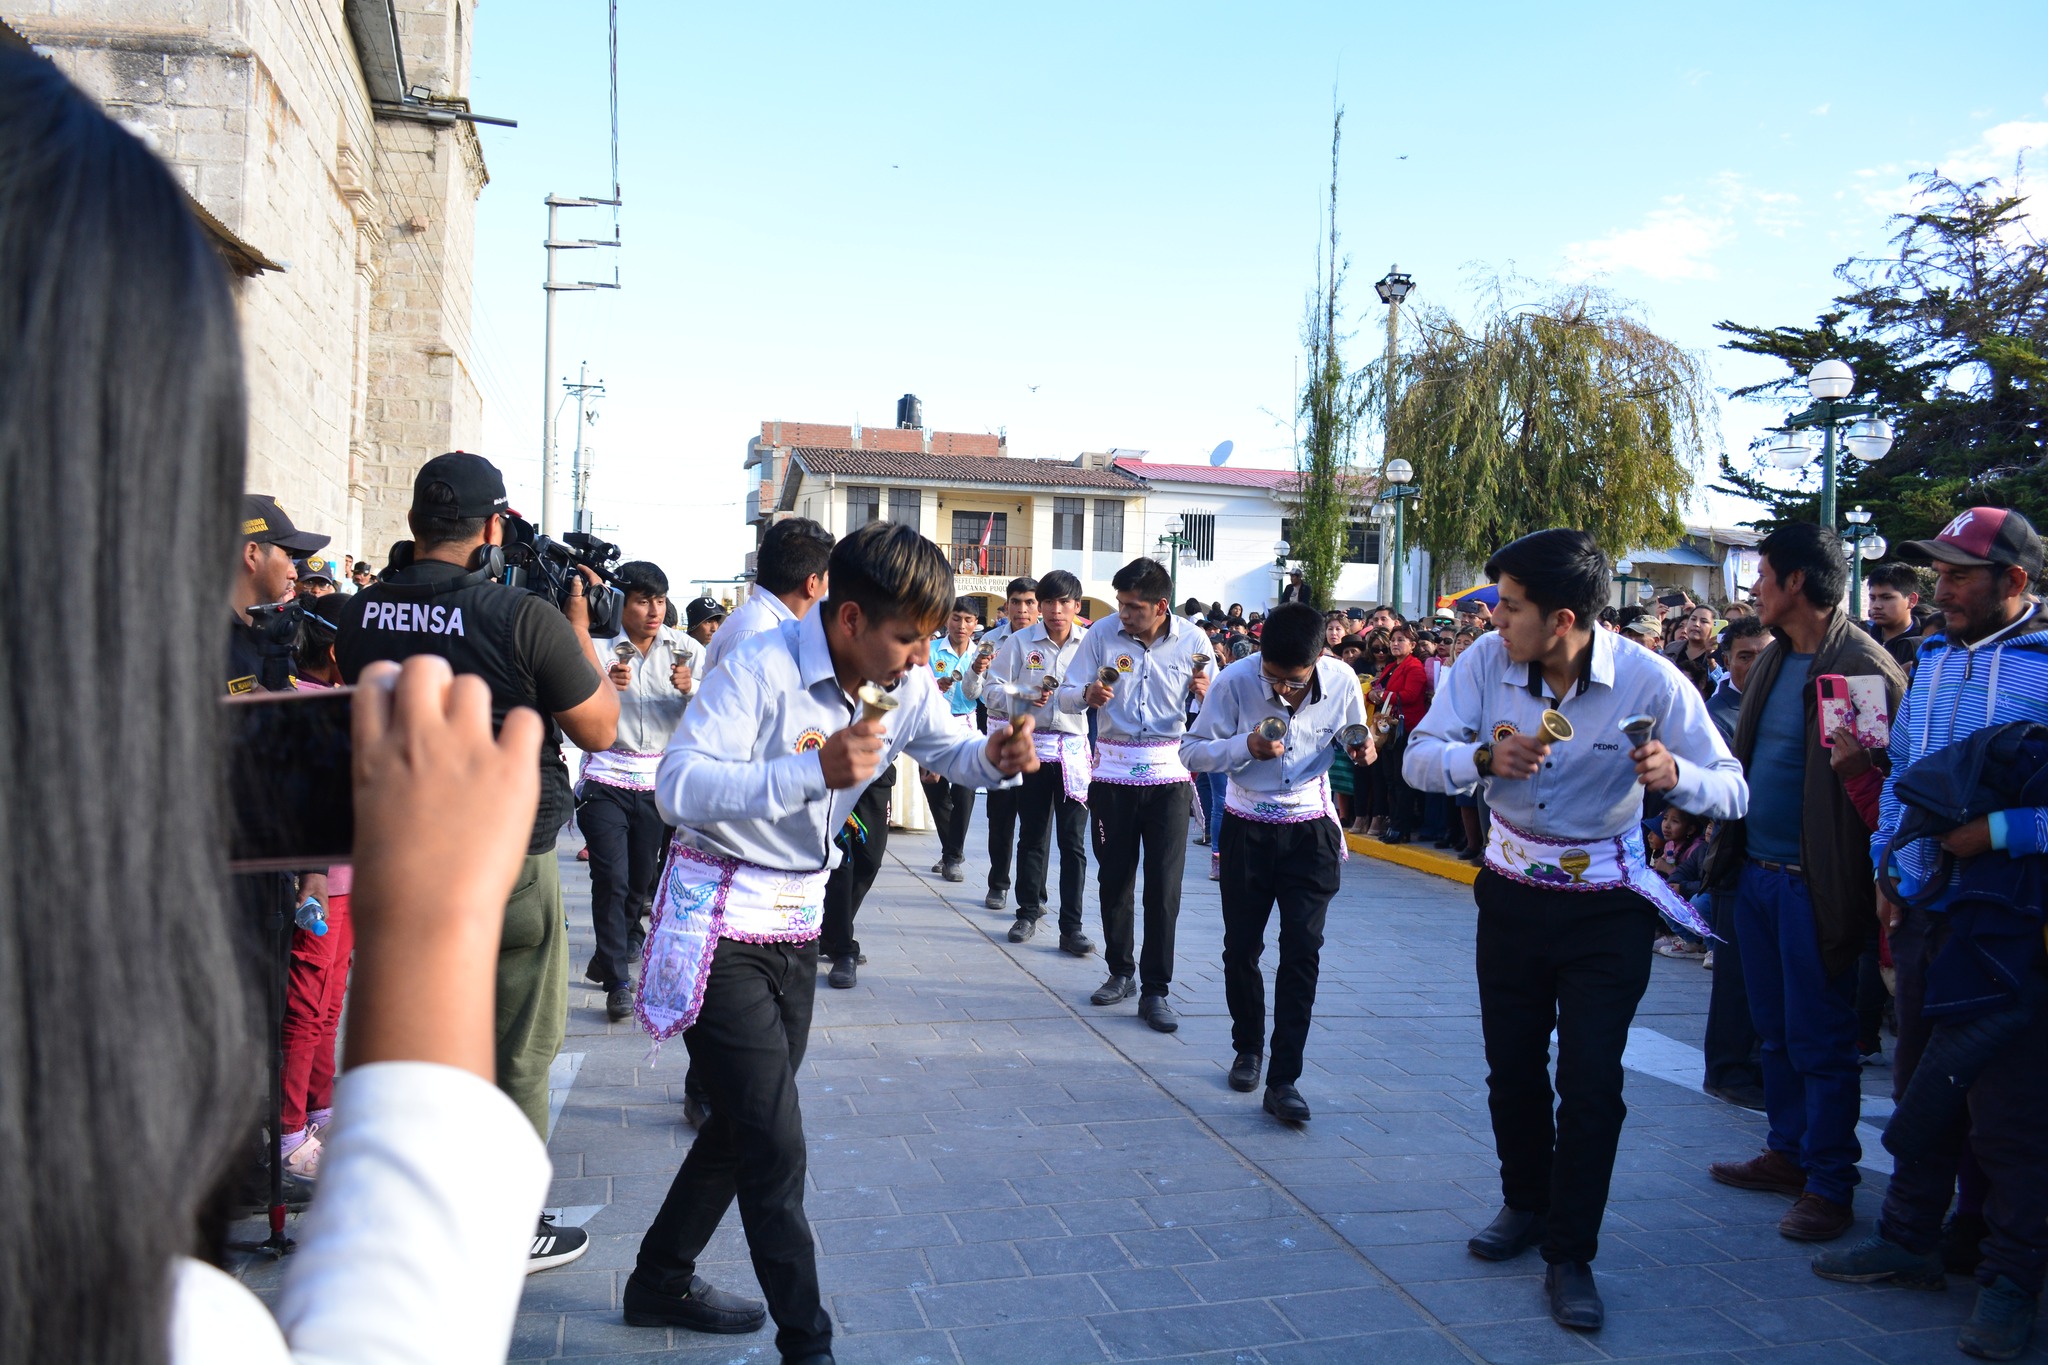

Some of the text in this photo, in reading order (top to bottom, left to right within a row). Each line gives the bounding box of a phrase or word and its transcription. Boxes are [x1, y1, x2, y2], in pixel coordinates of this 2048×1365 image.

[954, 577, 1011, 587] REFECTURA PROVIN
[989, 585, 1007, 593] PUQU
[362, 601, 465, 637] PRENSA
[1593, 743, 1619, 751] PEDRO
[1098, 818, 1106, 845] ASP
